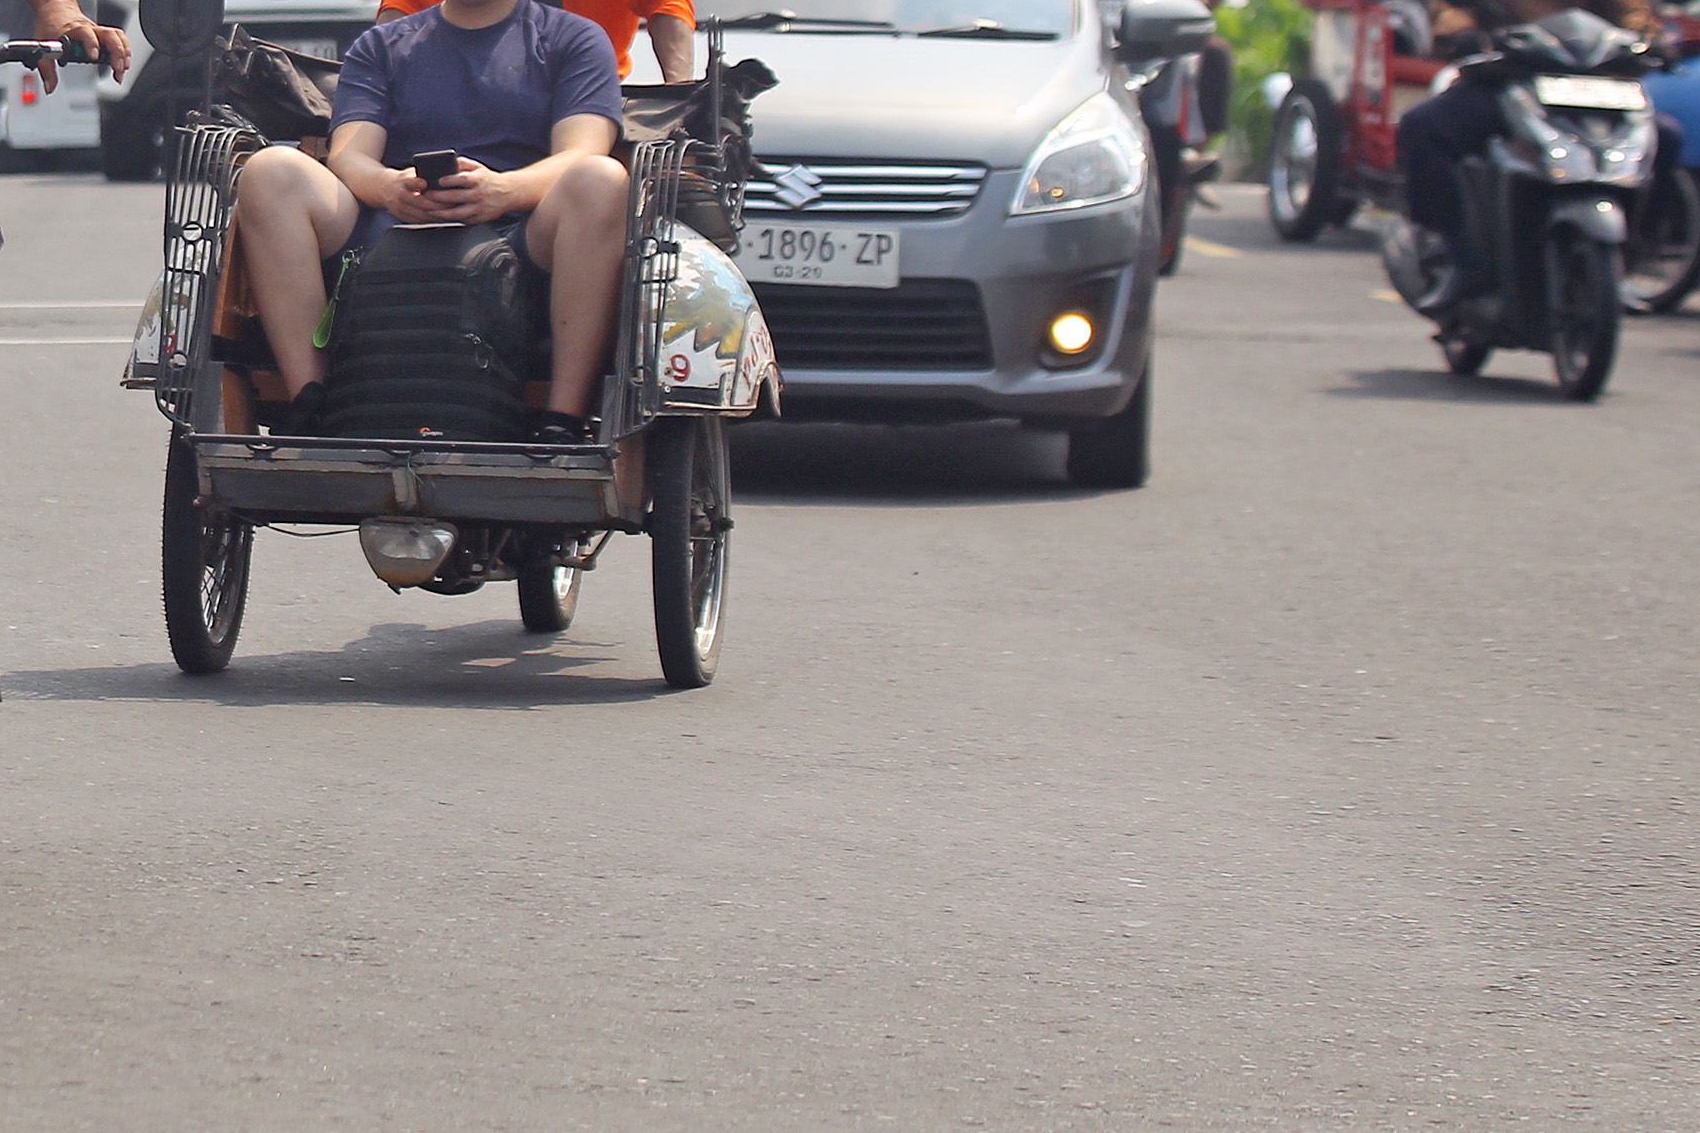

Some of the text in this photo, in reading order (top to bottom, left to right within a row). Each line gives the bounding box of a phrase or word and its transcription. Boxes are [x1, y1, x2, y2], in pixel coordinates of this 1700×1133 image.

[758, 228, 836, 263] 1896
[856, 232, 894, 266] ZP
[670, 353, 691, 383] 9
